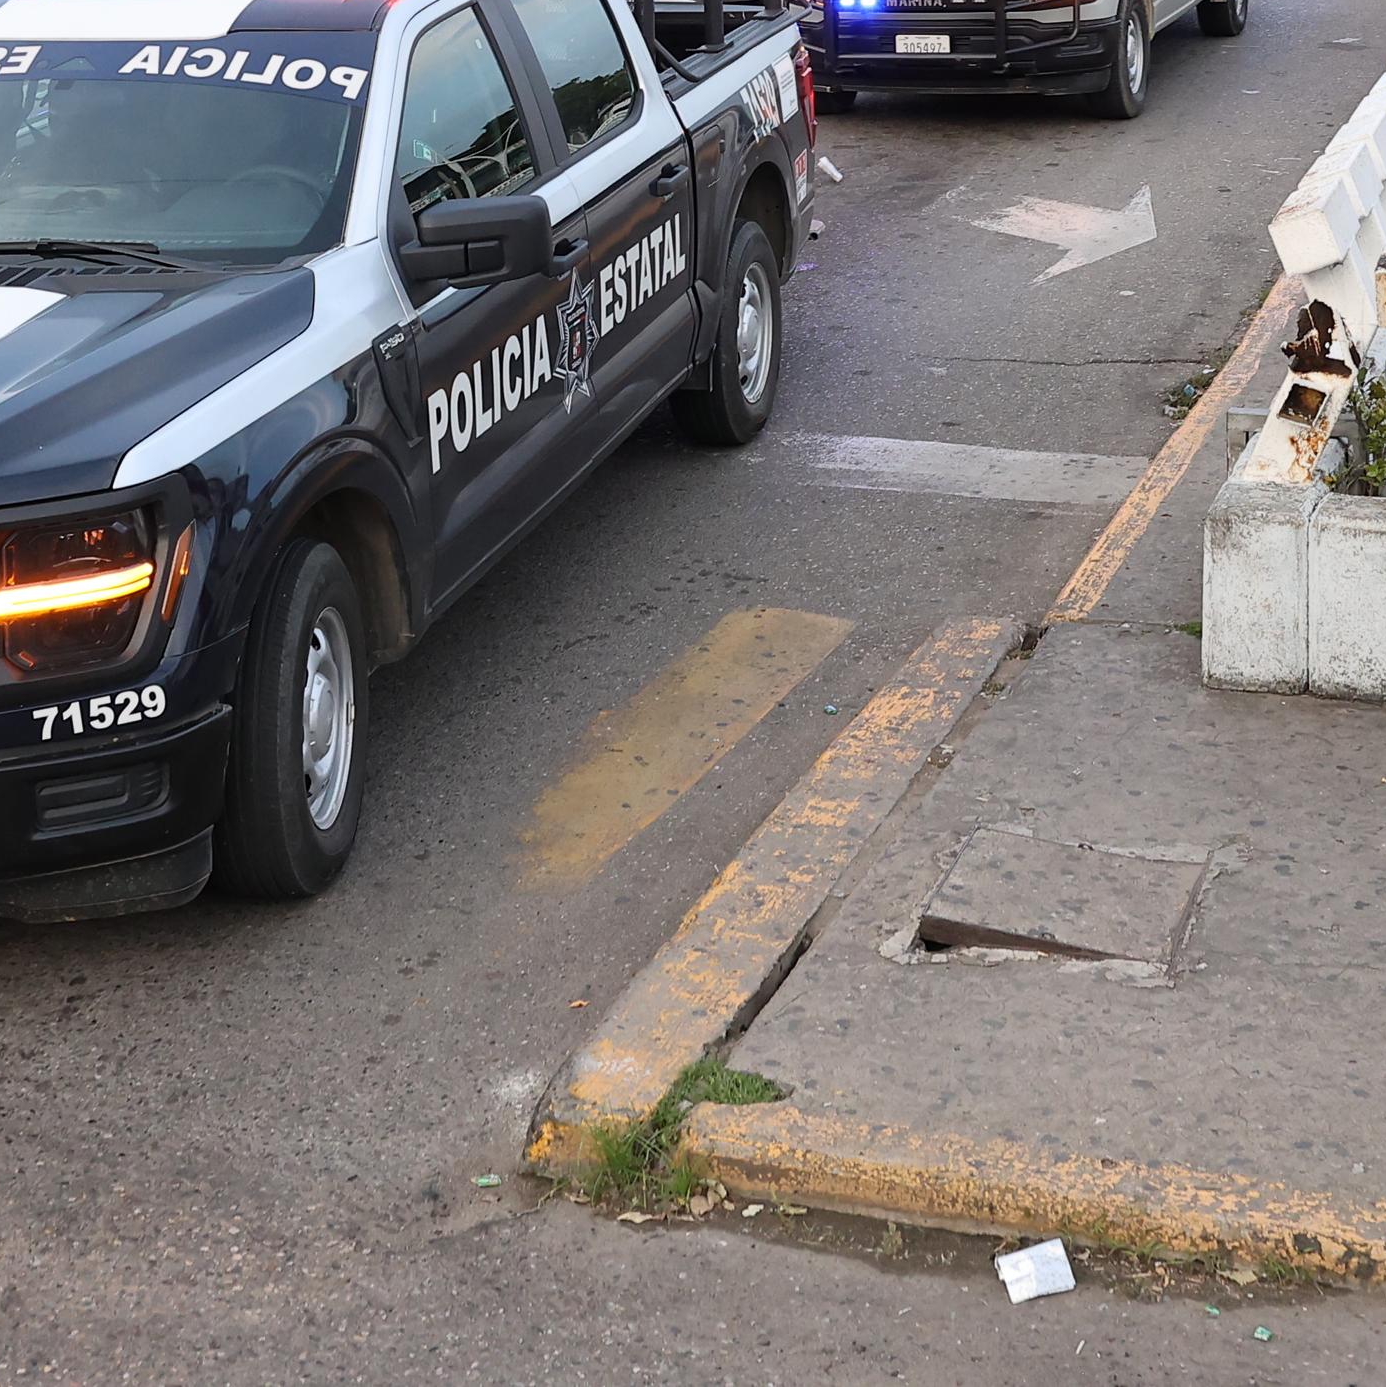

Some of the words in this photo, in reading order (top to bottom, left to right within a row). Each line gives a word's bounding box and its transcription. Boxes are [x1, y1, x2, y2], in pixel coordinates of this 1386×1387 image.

[426, 314, 553, 475] POLICIA
[598, 213, 686, 338] ESTATAL
[32, 684, 166, 741] 71529
